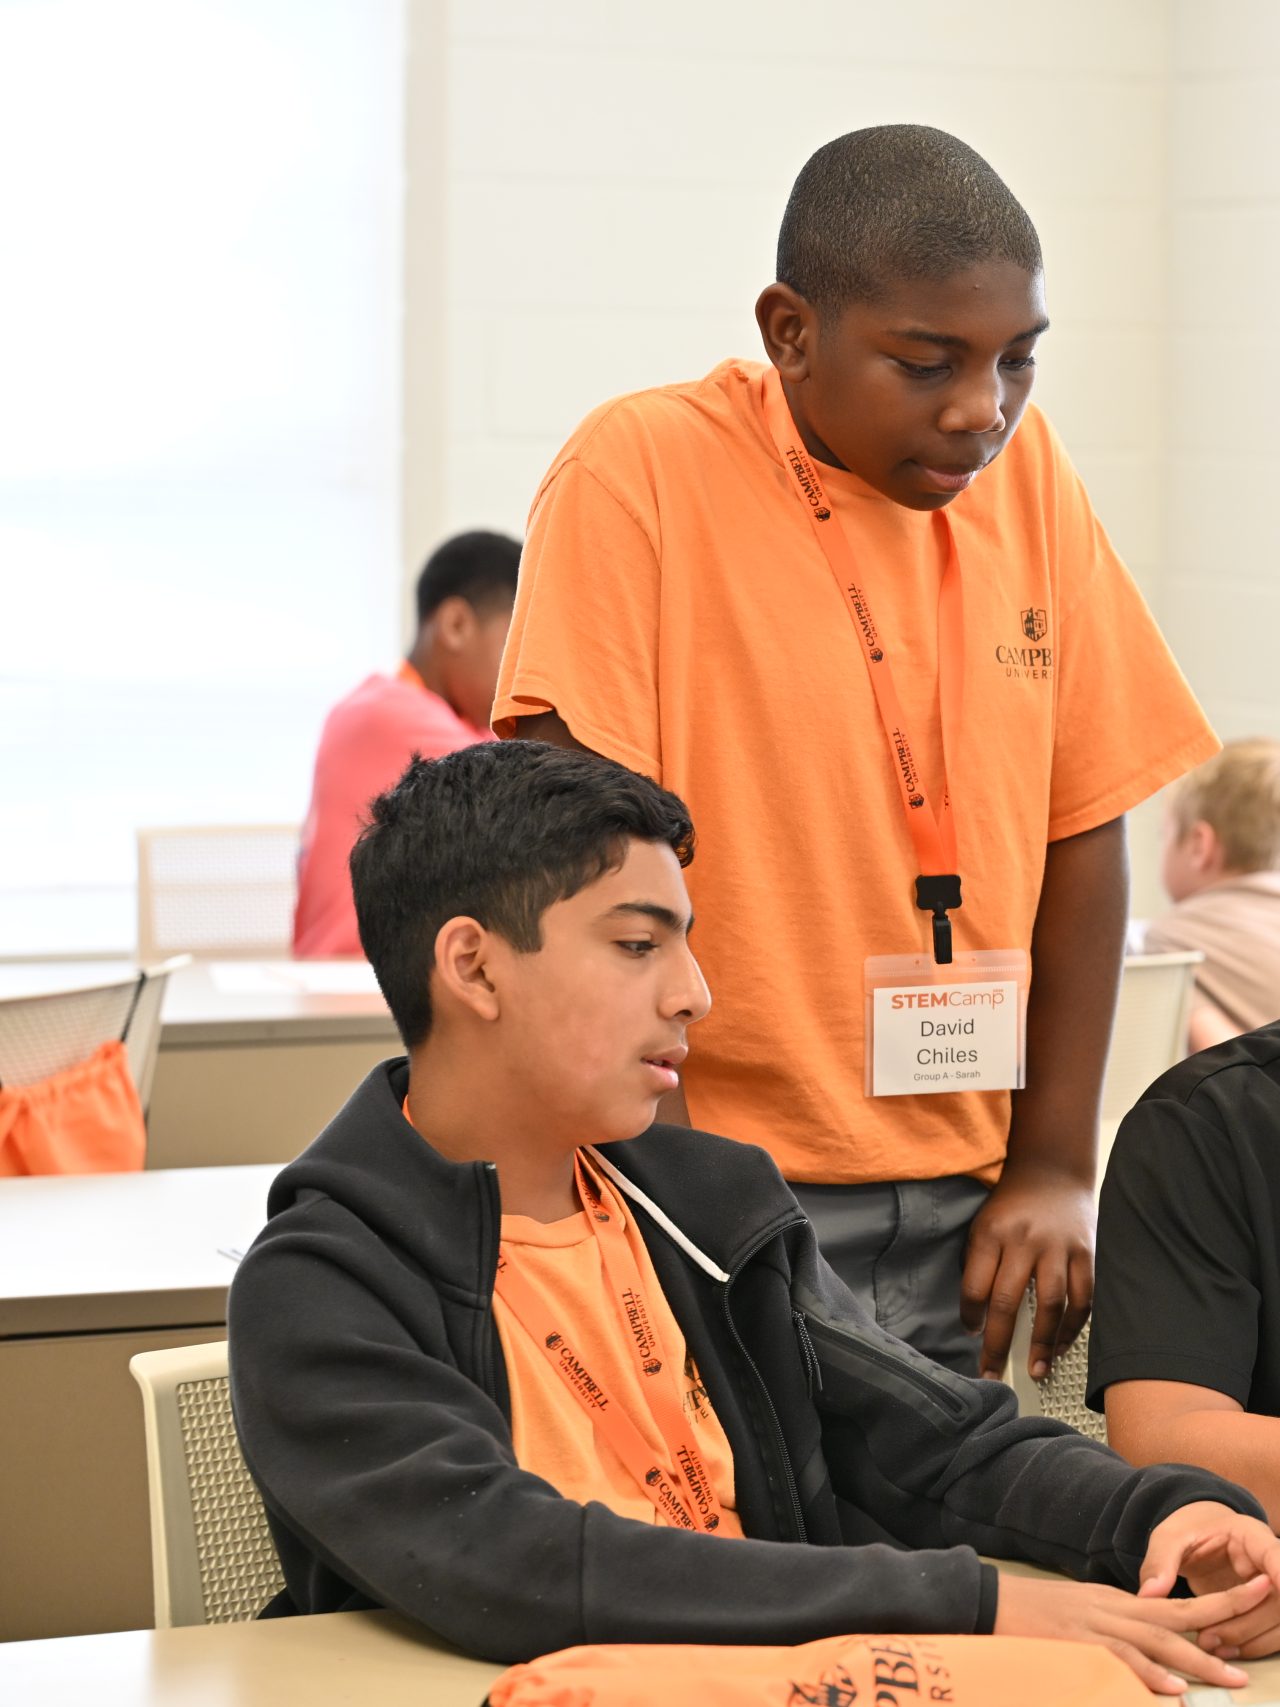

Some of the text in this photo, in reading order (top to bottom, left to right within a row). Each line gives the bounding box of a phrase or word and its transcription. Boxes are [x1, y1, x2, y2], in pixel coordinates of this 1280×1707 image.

[786, 446, 819, 506] CAMPBELL
[797, 450, 823, 498] UNIVERSITY
[848, 583, 875, 647] CAMPBELL
[858, 589, 878, 638] UNIVERSITY
[995, 644, 1053, 667] CAMPB
[892, 727, 915, 793] CAMPBELL
[891, 990, 1004, 1010] STEMCamp
[920, 1018, 975, 1037] David
[914, 1072, 941, 1081] Group
[956, 1070, 981, 1079] Sarah
[916, 1047, 978, 1065] Chiles
[622, 1287, 651, 1358] CAMPBELL
[634, 1293, 656, 1348] UNIVERSITY
[559, 1360, 597, 1408] UNIVERSITY
[560, 1347, 609, 1411] CAMPBELL
[676, 1444, 709, 1515] CAMPBELL
[689, 1450, 713, 1503] UNIVERSITY
